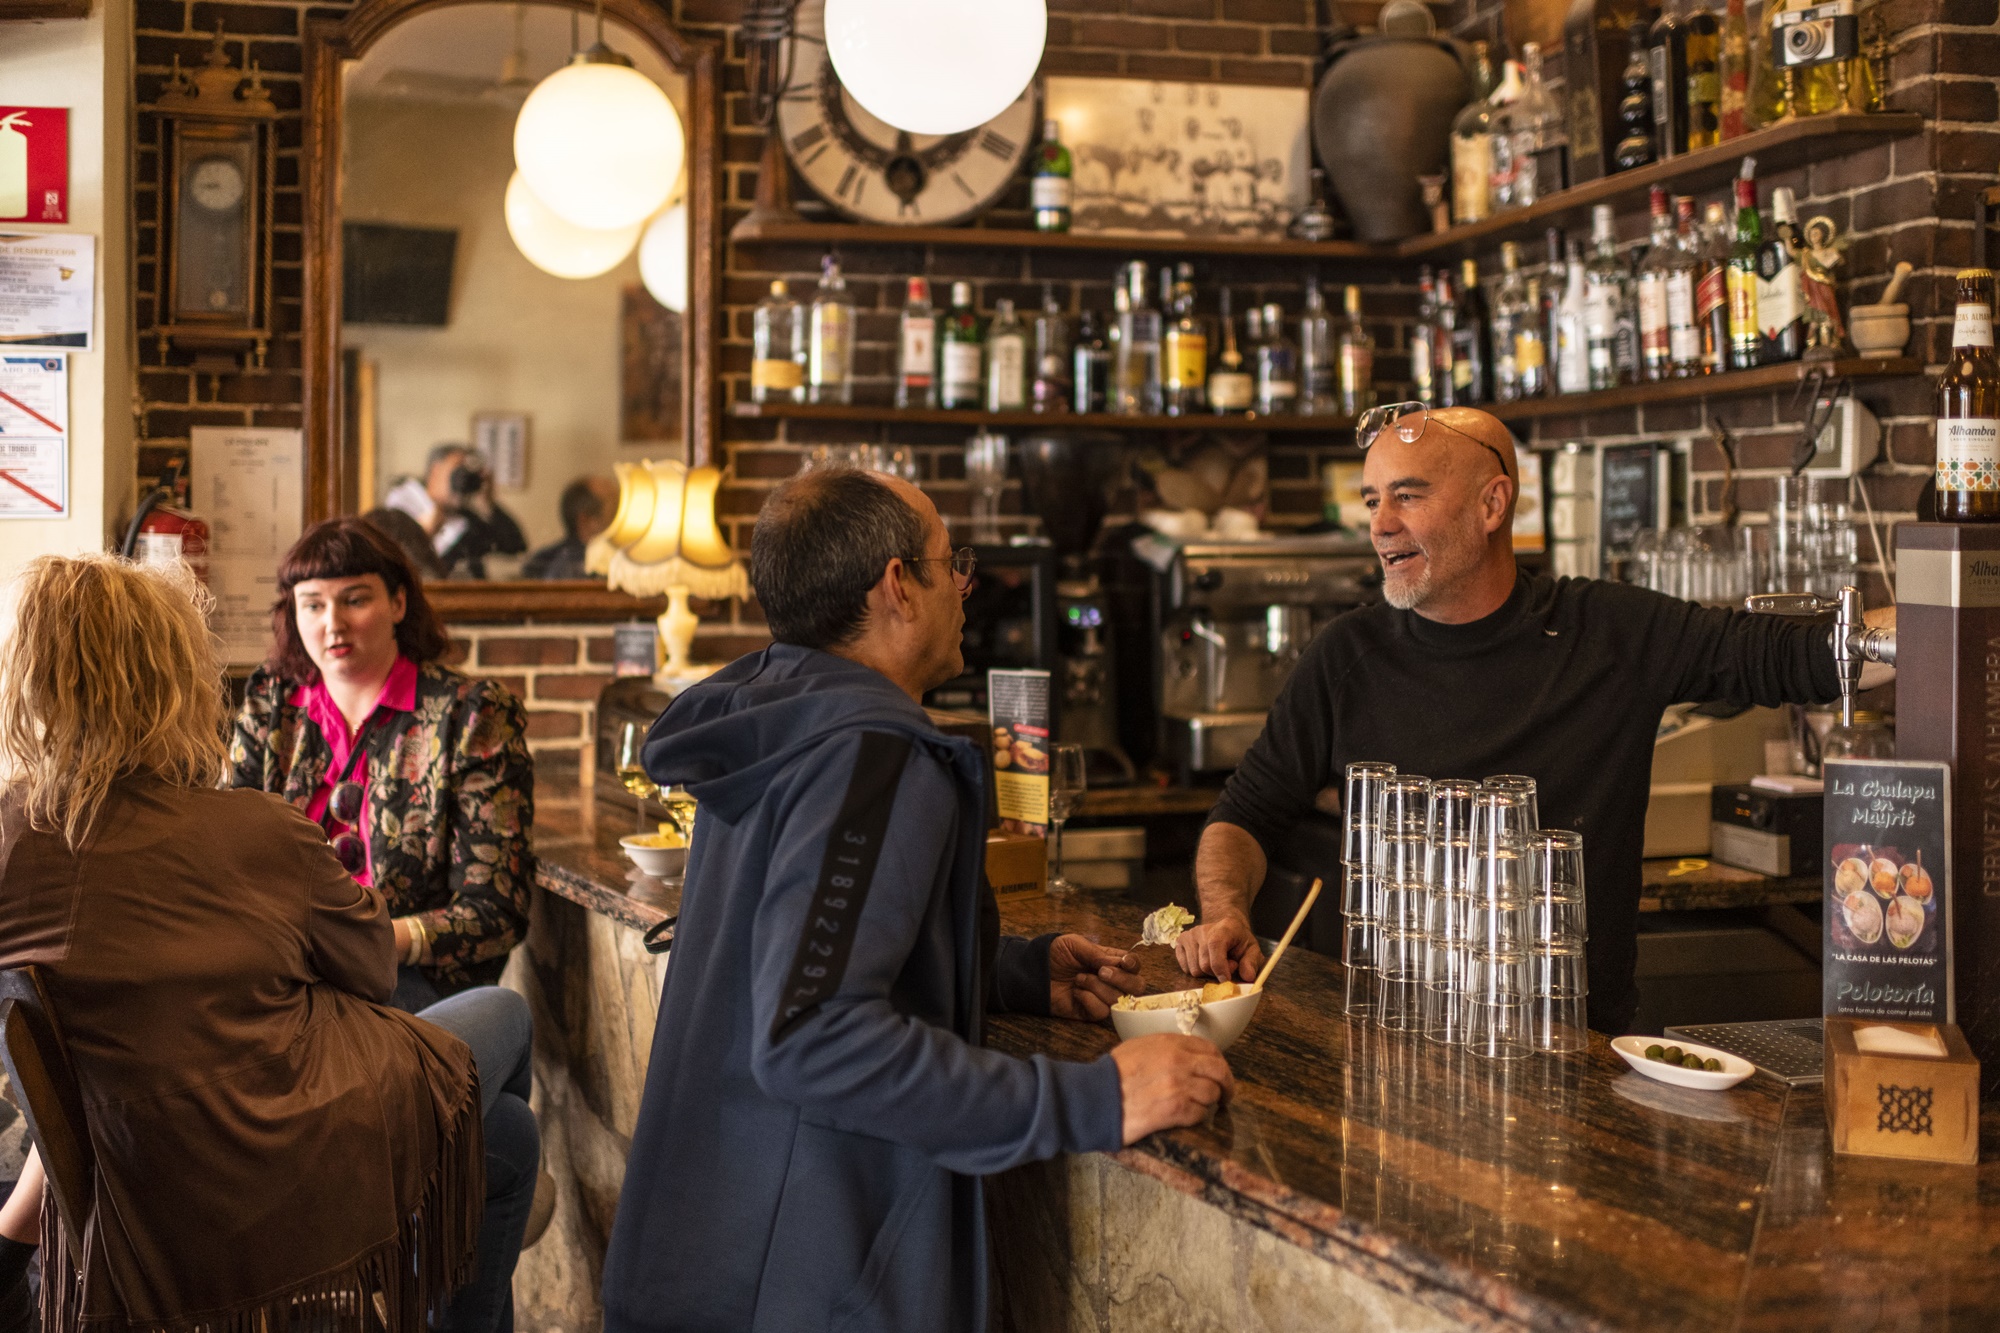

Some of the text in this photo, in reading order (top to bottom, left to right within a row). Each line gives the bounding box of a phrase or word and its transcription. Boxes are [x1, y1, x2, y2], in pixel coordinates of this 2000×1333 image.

[1949, 425, 1996, 437] Alhambra
[1969, 560, 2000, 577] Alha
[1833, 779, 1935, 804] La Chulapa
[1871, 799, 1894, 811] en
[1851, 808, 1916, 829] Mayrit
[1846, 954, 1868, 963] CASA
[1882, 956, 1897, 964] LAS
[1837, 981, 1936, 1004] Pelotería
